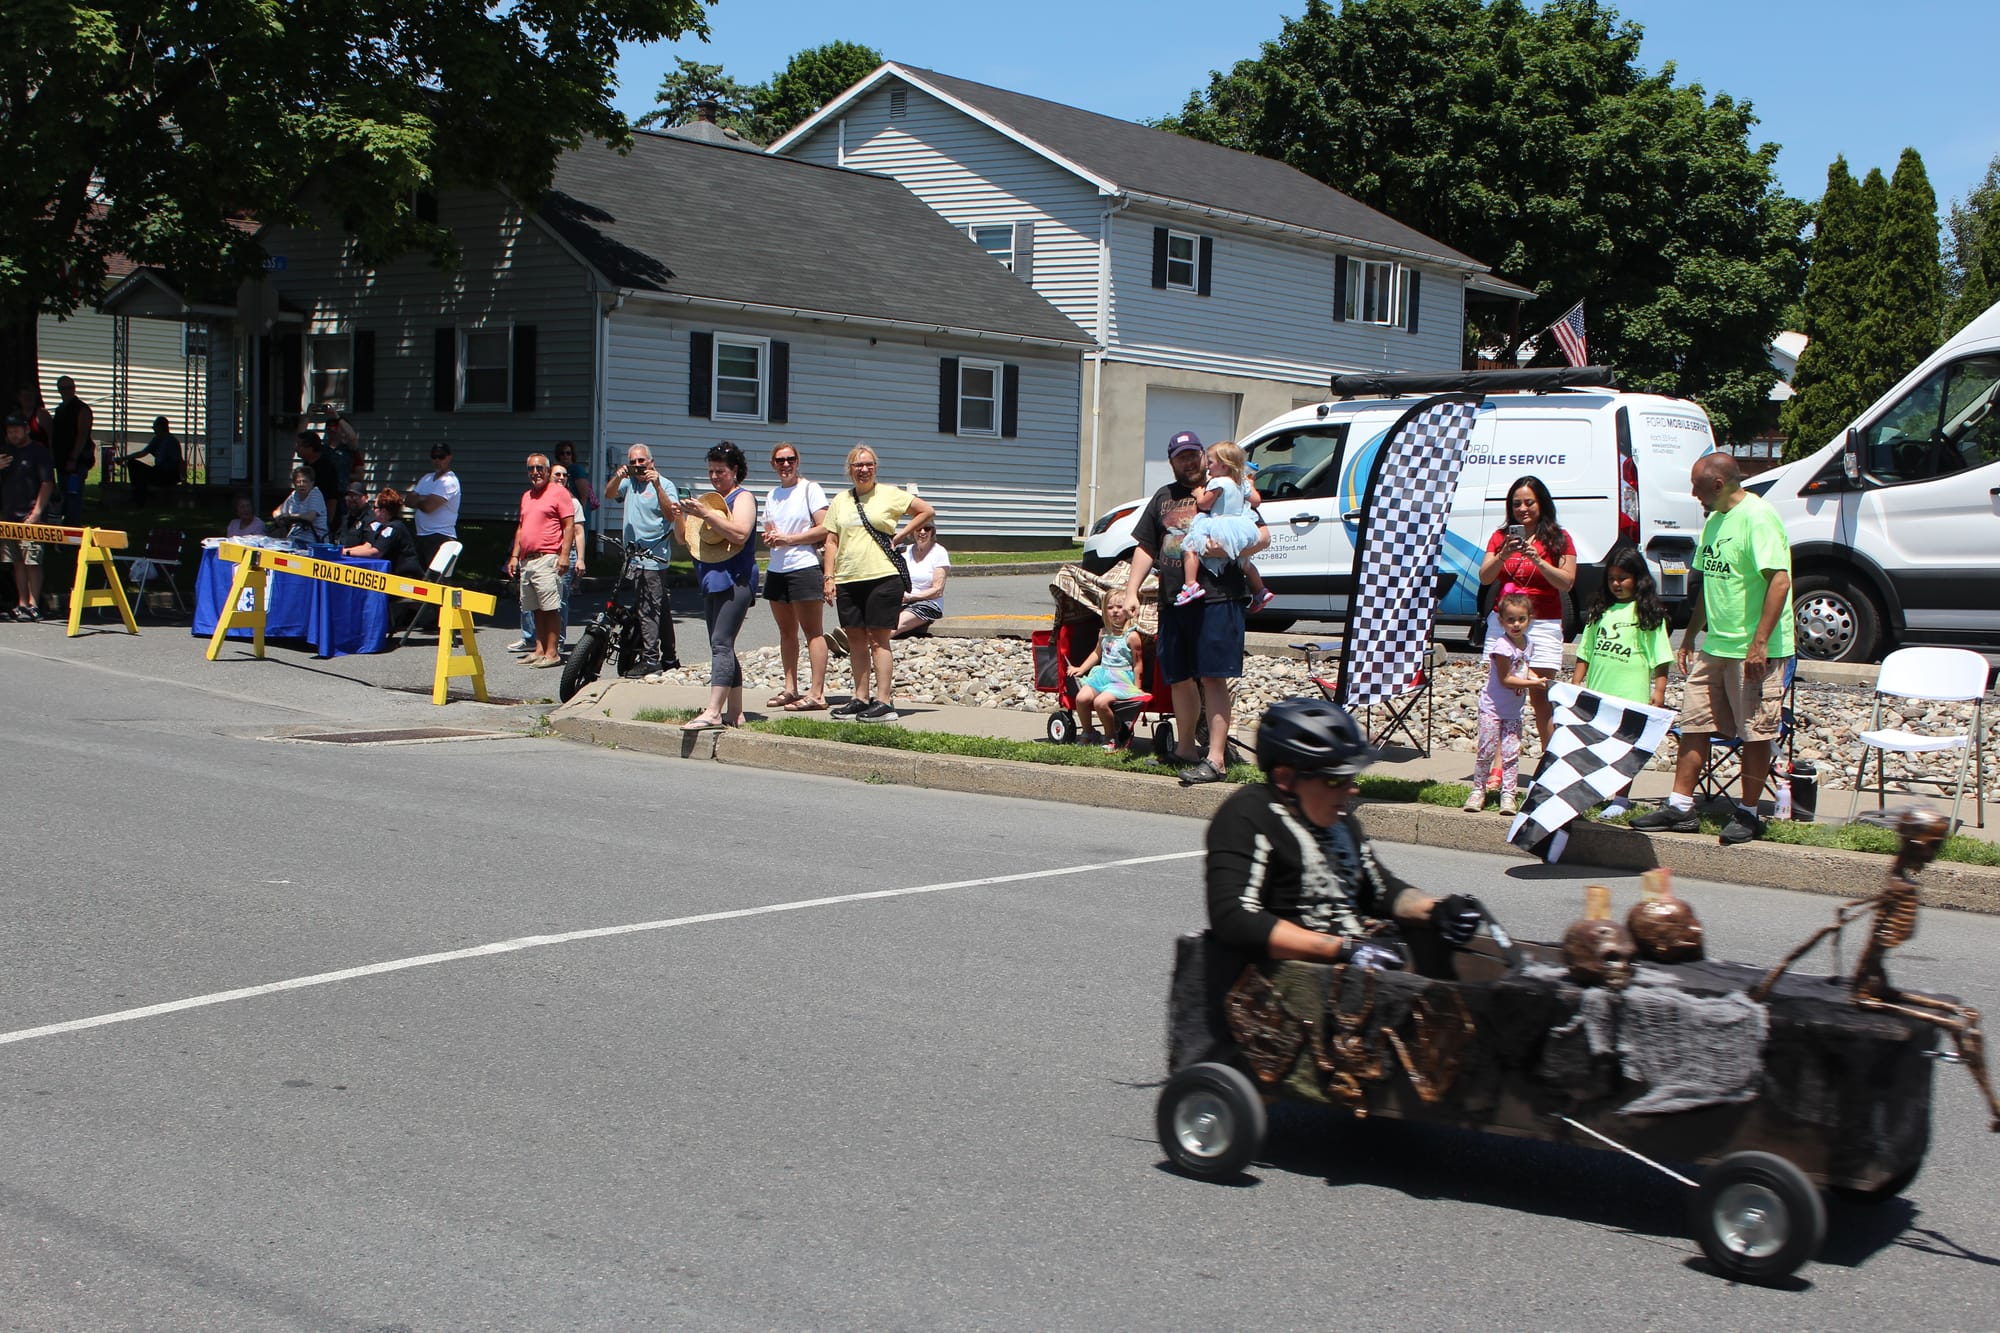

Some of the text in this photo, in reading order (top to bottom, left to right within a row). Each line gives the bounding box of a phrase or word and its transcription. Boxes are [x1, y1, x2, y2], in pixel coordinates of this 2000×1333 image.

[1667, 418, 1690, 430] MOBILE
[1467, 444, 1489, 454] ORD
[1509, 454, 1567, 465] SERVICE
[0, 525, 64, 541] ROAD CLOSED
[1279, 534, 1299, 543] Ford
[312, 562, 387, 591] ROAD CLOSED
